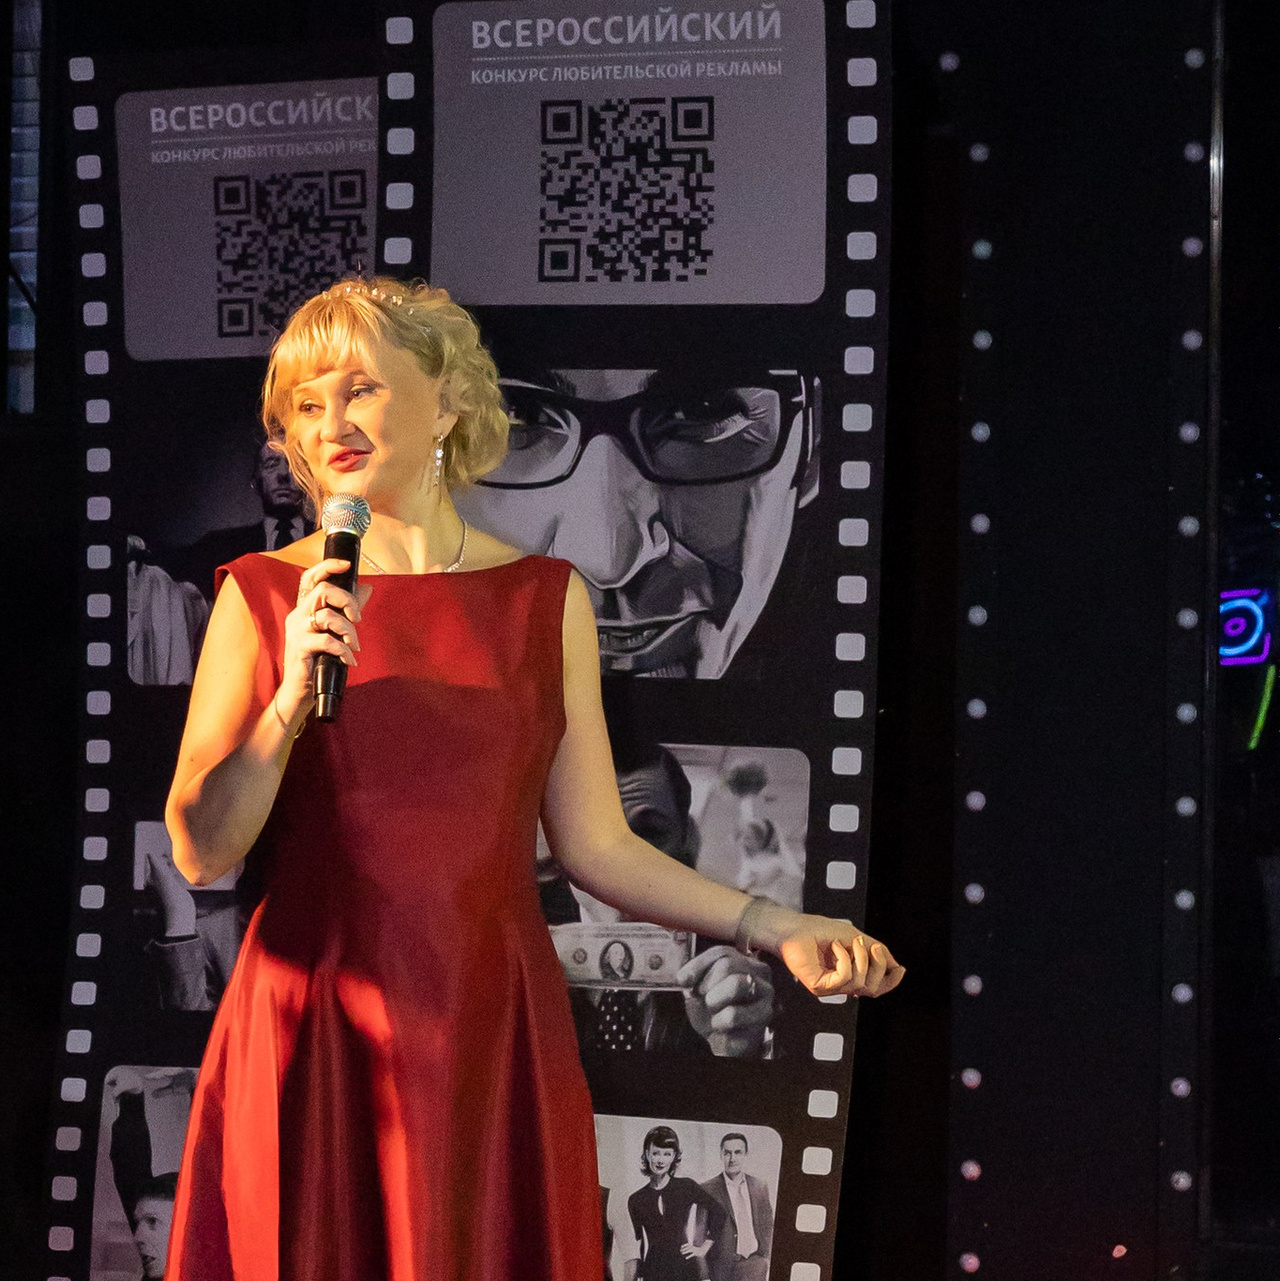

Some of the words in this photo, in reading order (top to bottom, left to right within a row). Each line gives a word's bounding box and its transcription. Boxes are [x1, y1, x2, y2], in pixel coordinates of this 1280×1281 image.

[470, 2, 782, 49] ВСЕРОССИЙСКИЙ
[470, 66, 548, 85] КОНКУРС
[551, 60, 691, 81] ЛЮБИТЕЛЬСКОЙ
[695, 59, 782, 78] РЕКЛАМЫ
[150, 91, 376, 133] ВСЕРОССИЙСК
[151, 147, 220, 164] КОНКУРС
[222, 137, 346, 160] ЛЮБИТЕЛЬСКОЙ
